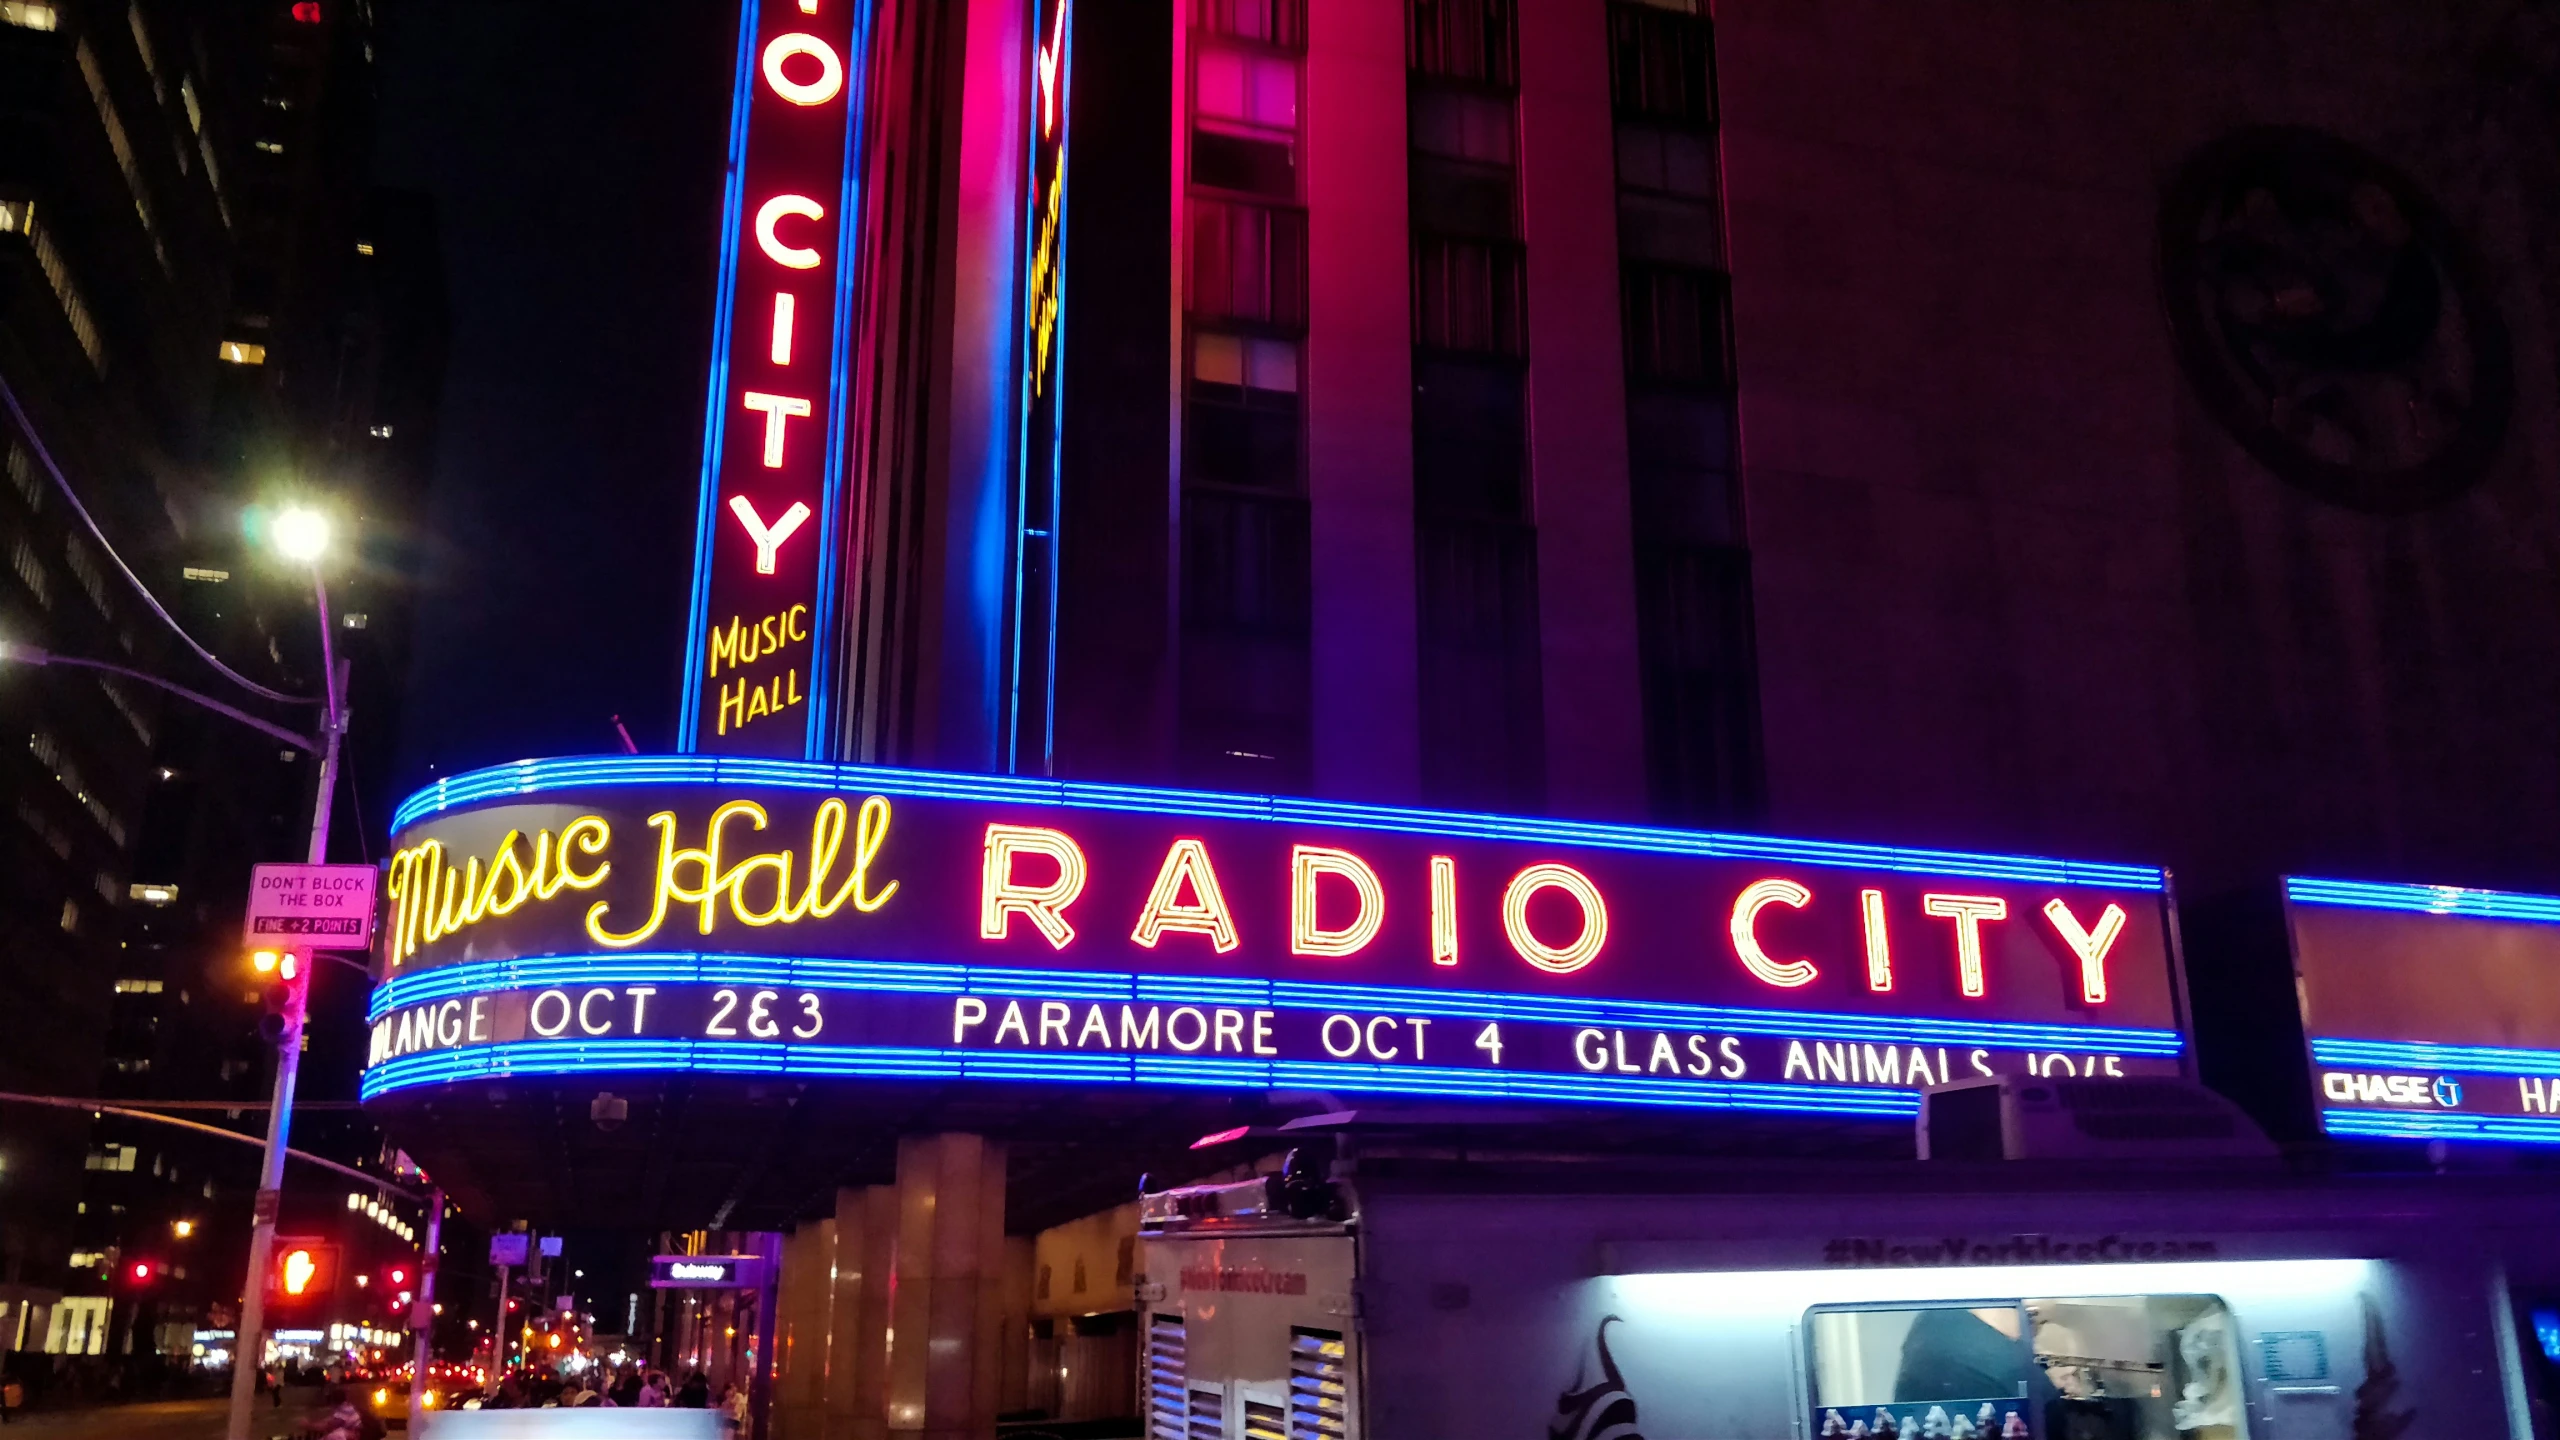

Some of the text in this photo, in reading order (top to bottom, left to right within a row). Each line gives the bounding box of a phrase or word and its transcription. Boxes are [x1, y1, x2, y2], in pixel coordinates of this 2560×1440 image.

[729, 194, 824, 574] CITY
[710, 603, 808, 678] MUSIC
[717, 668, 802, 736] HALL
[261, 876, 365, 891] DON'T BLOCK
[279, 893, 344, 907] THE BOX
[388, 794, 900, 967] Music Hall
[980, 822, 2127, 1004] RADIO CITY
[257, 918, 285, 932] FINE
[313, 919, 358, 933] POINTS
[530, 987, 657, 1036] OCT
[953, 997, 1278, 1055] PARAMORE
[1322, 1014, 1432, 1060] OCT
[1476, 1022, 1504, 1065] 4
[1575, 1028, 1747, 1079] GLASS
[2322, 1072, 2433, 1104] CHASE
